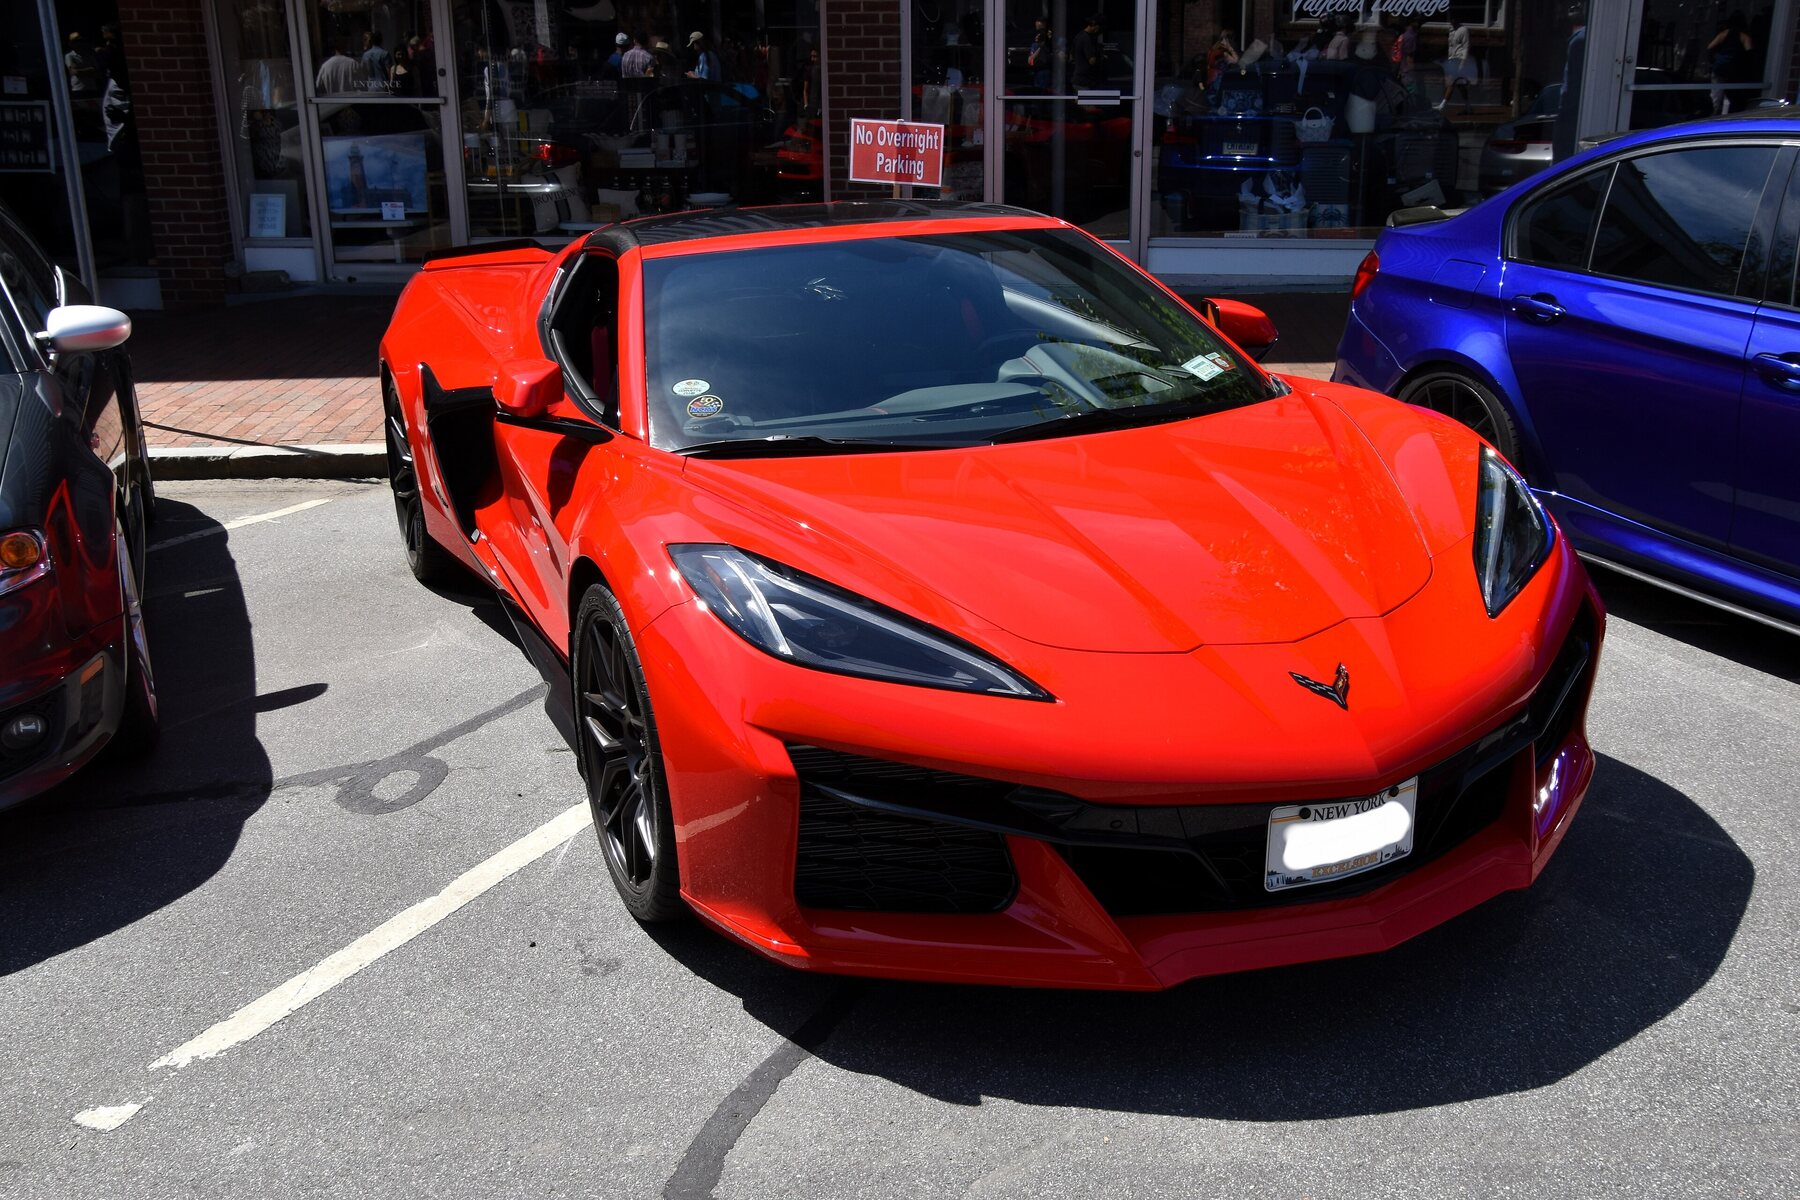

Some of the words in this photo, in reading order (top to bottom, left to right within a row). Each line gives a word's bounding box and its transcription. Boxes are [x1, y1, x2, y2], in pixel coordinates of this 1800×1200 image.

[856, 125, 873, 145] No
[877, 126, 939, 154] Overnight
[876, 152, 924, 180] Parking
[1312, 804, 1350, 821] NEW
[1354, 791, 1388, 815] YORK
